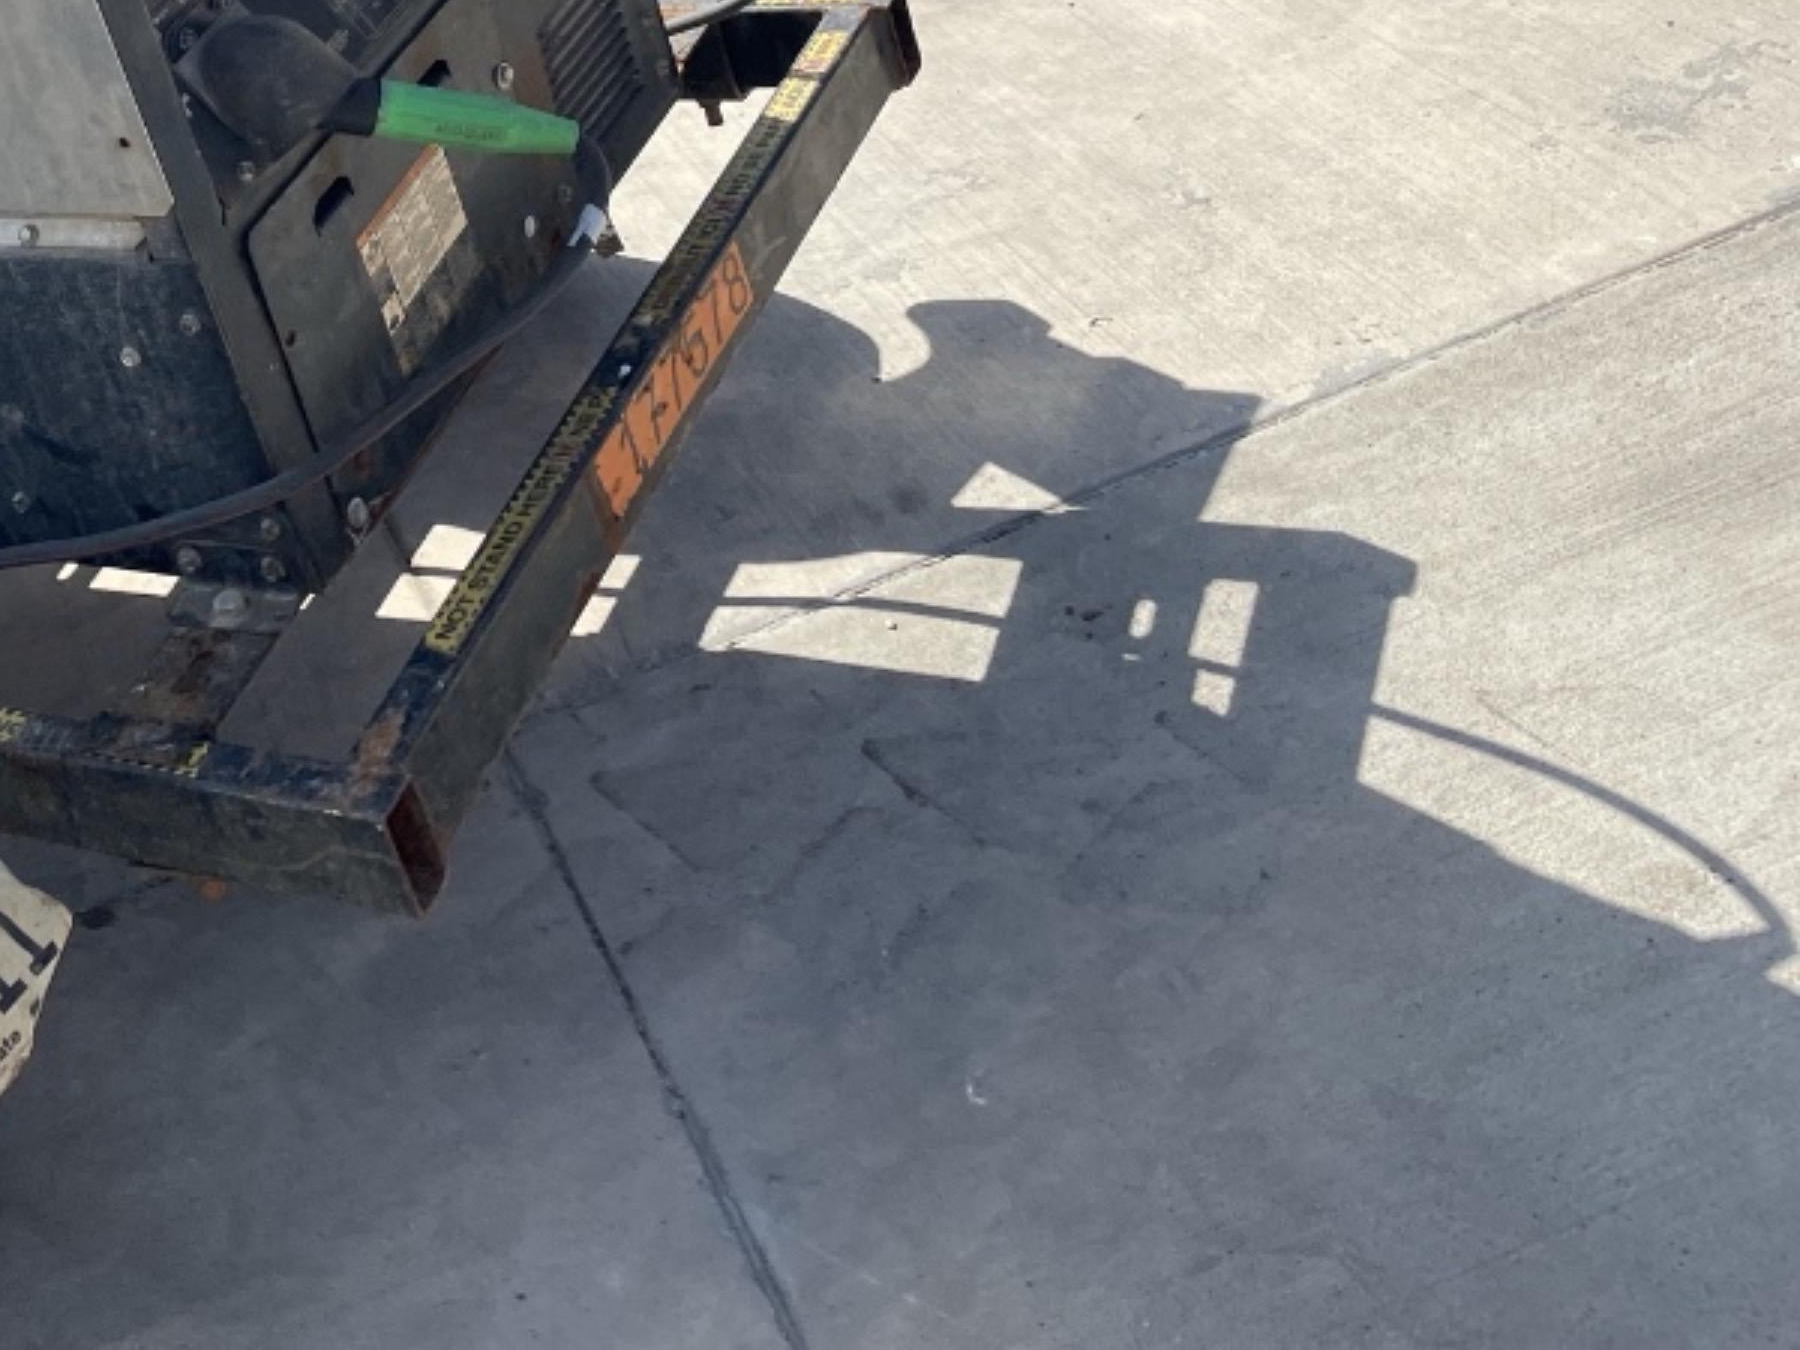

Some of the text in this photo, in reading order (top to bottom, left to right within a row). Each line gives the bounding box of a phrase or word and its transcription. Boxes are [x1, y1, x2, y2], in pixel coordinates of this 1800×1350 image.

[434, 589, 476, 641] NOT
[467, 521, 525, 592] STAND
[520, 461, 563, 517] HERE
